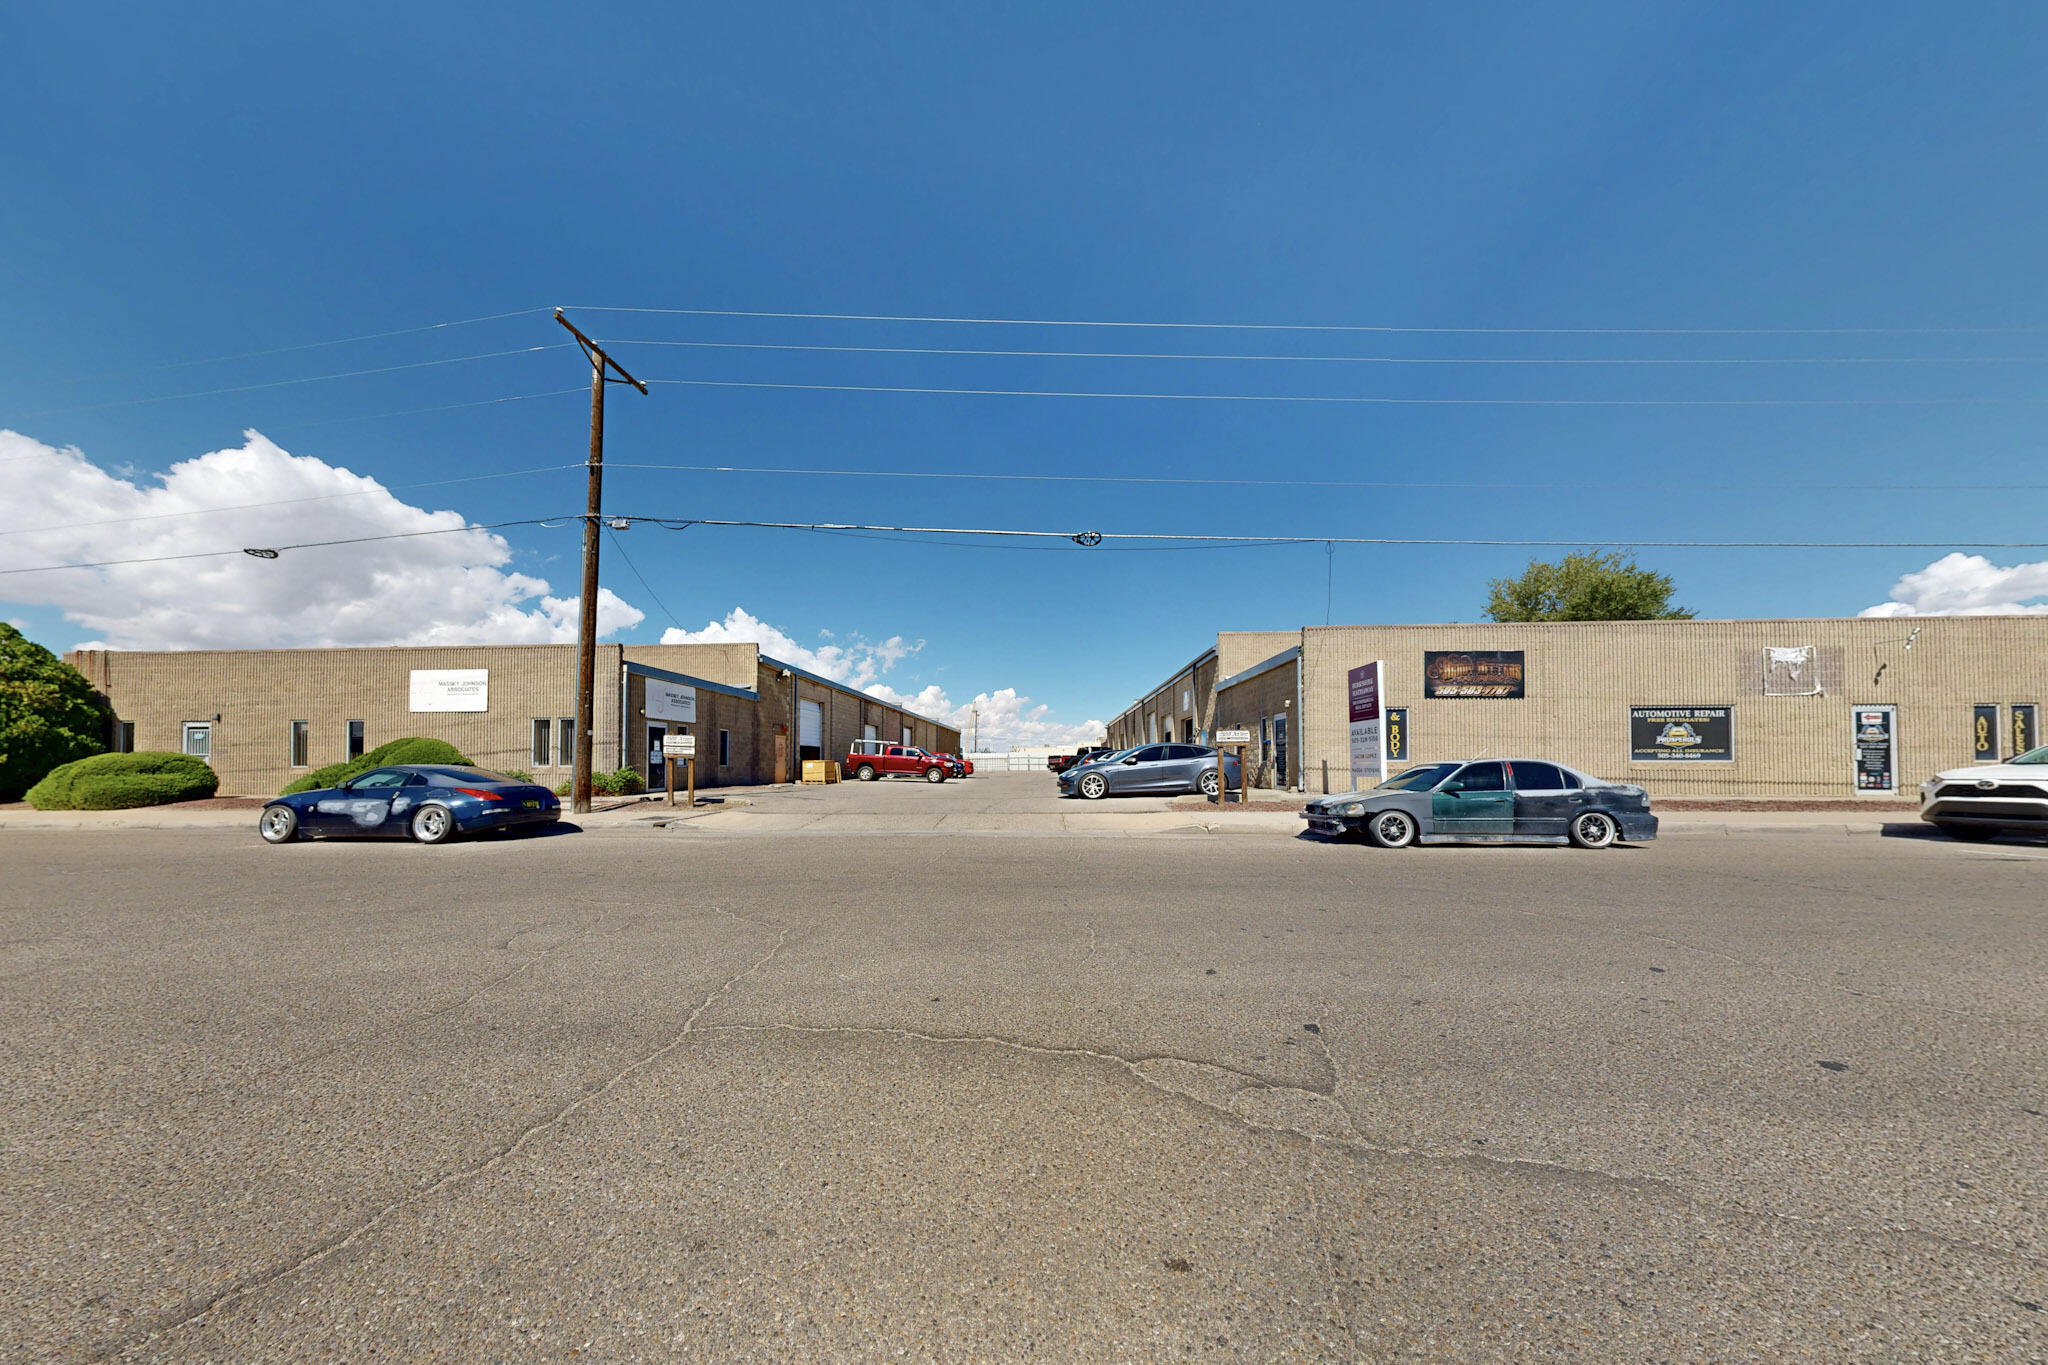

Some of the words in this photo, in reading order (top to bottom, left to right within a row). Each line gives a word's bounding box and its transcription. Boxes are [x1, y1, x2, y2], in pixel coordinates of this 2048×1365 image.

[1390, 712, 1400, 721] &
[1632, 709, 1691, 718] AUTOMOTIVE
[1694, 709, 1726, 718] REPAIR
[1351, 726, 1378, 736] AVAILABLE
[1389, 725, 1400, 758] BODY
[1976, 715, 1989, 752] AUTO
[2014, 710, 2026, 755] SALES
